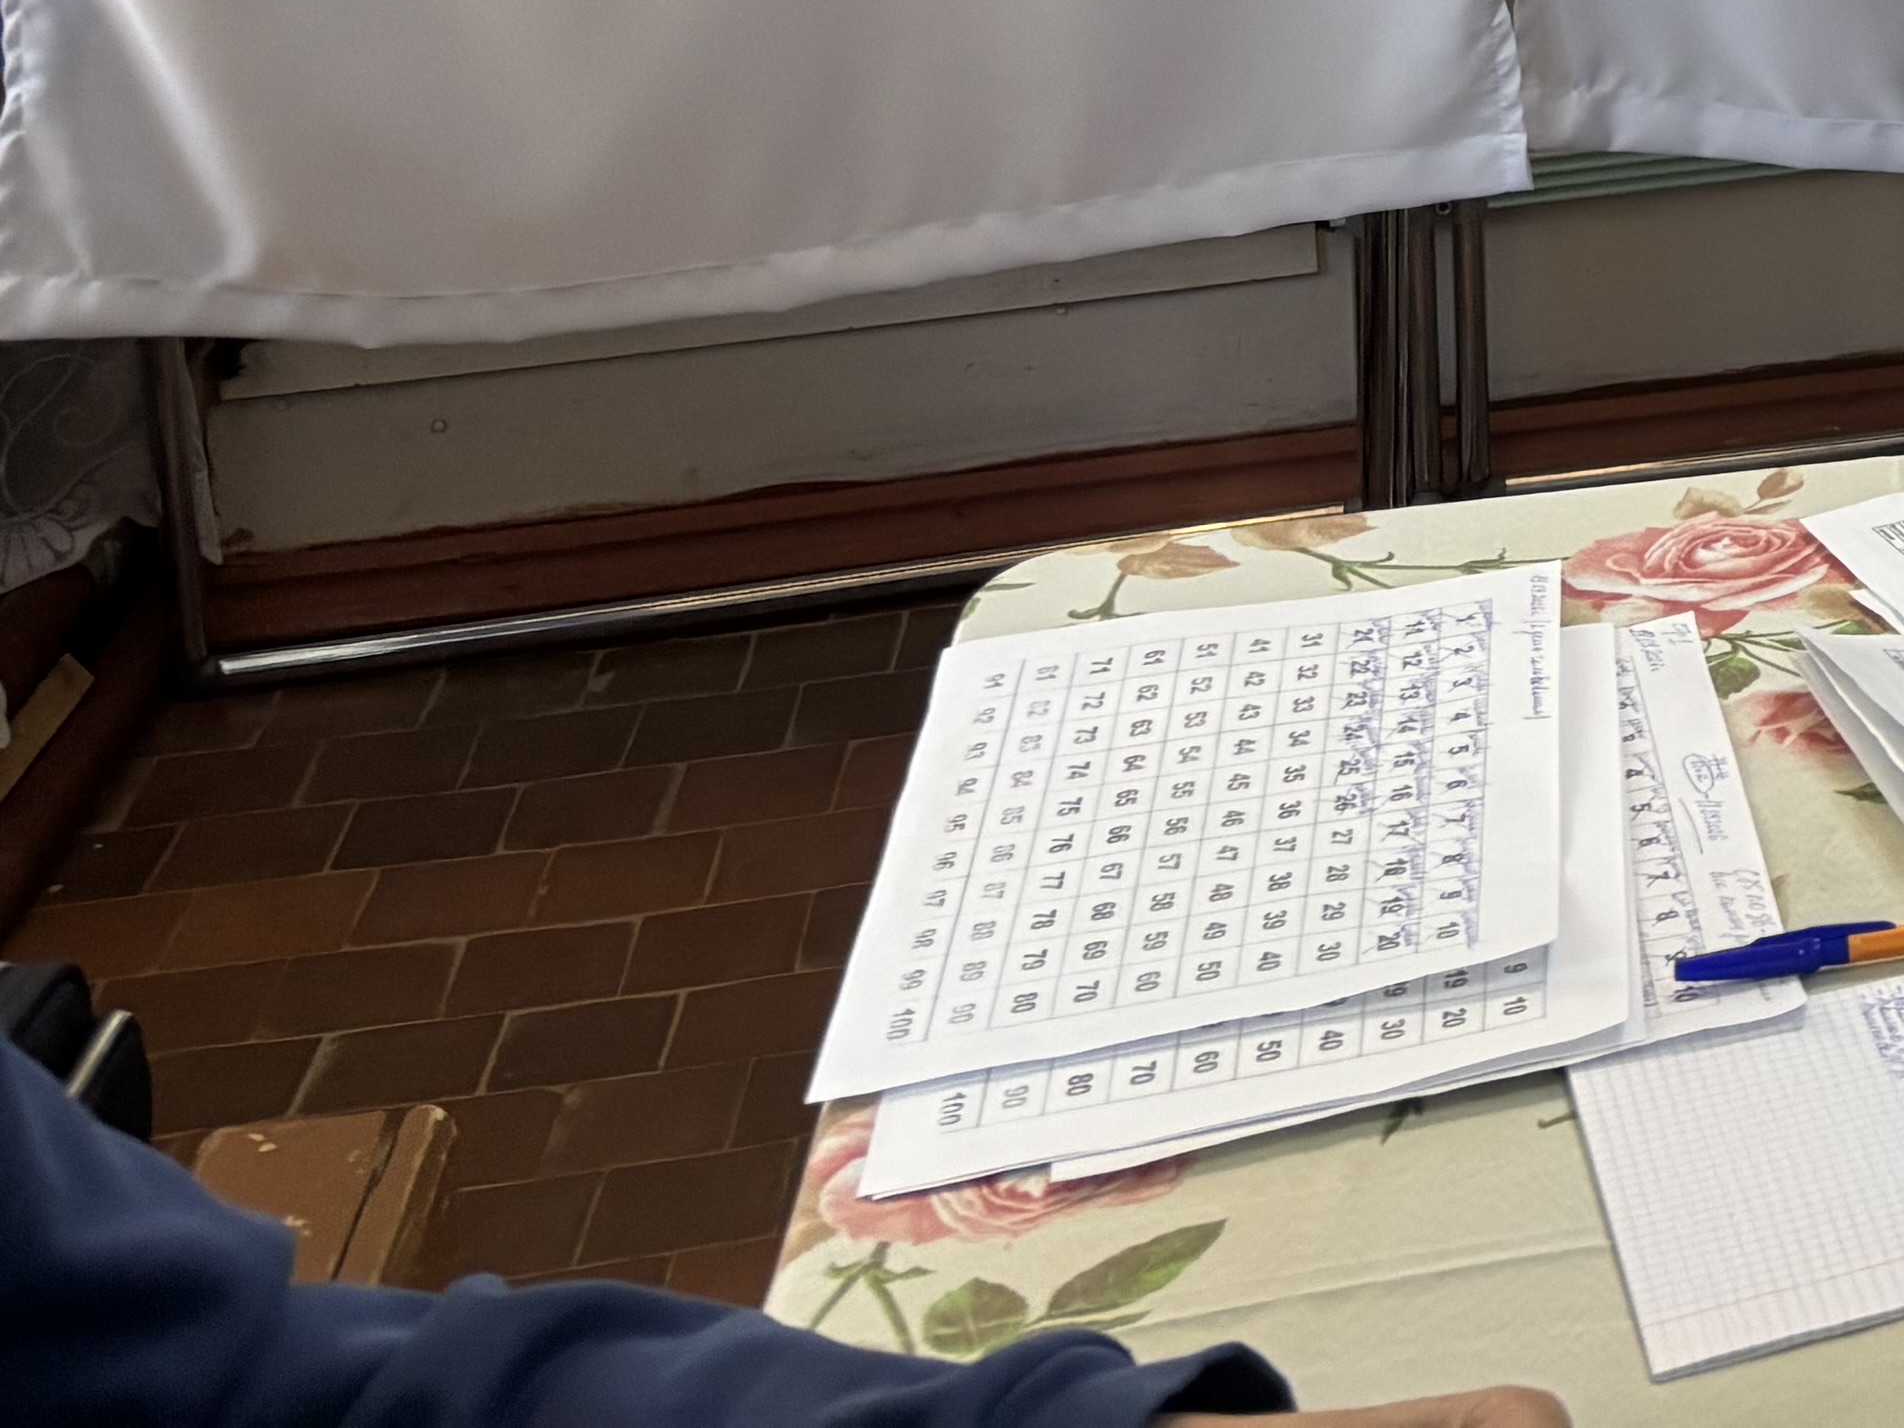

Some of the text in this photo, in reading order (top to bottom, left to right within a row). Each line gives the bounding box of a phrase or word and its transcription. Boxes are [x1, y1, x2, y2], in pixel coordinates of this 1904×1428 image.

[1195, 638, 1272, 982] 41 42 43 44 45 46 47 48 49 50
[1256, 633, 1324, 972] 31 32 33 34 35 36 37 38 39 40
[1073, 649, 1166, 1003] 61 62 63 64 65 66 67 68 69 70
[1135, 643, 1219, 992] 51 52 53 54 55 56 57 58 59 60
[1010, 657, 1114, 1014] 71 72 73 74 75 76 77 78 79 80
[1330, 828, 1354, 845] 27
[1325, 864, 1350, 883] 28
[1321, 901, 1347, 921] 29
[1437, 919, 1461, 941] 10
[1316, 942, 1341, 962] 30
[1503, 996, 1527, 1015] 10
[1442, 1008, 1467, 1028] 20
[1319, 1030, 1344, 1051] 40
[1381, 1019, 1405, 1040] 30
[1256, 1040, 1282, 1062] 50
[1129, 1060, 1157, 1085] 70
[1193, 1051, 1219, 1074] 60
[1066, 1073, 1094, 1096] 80
